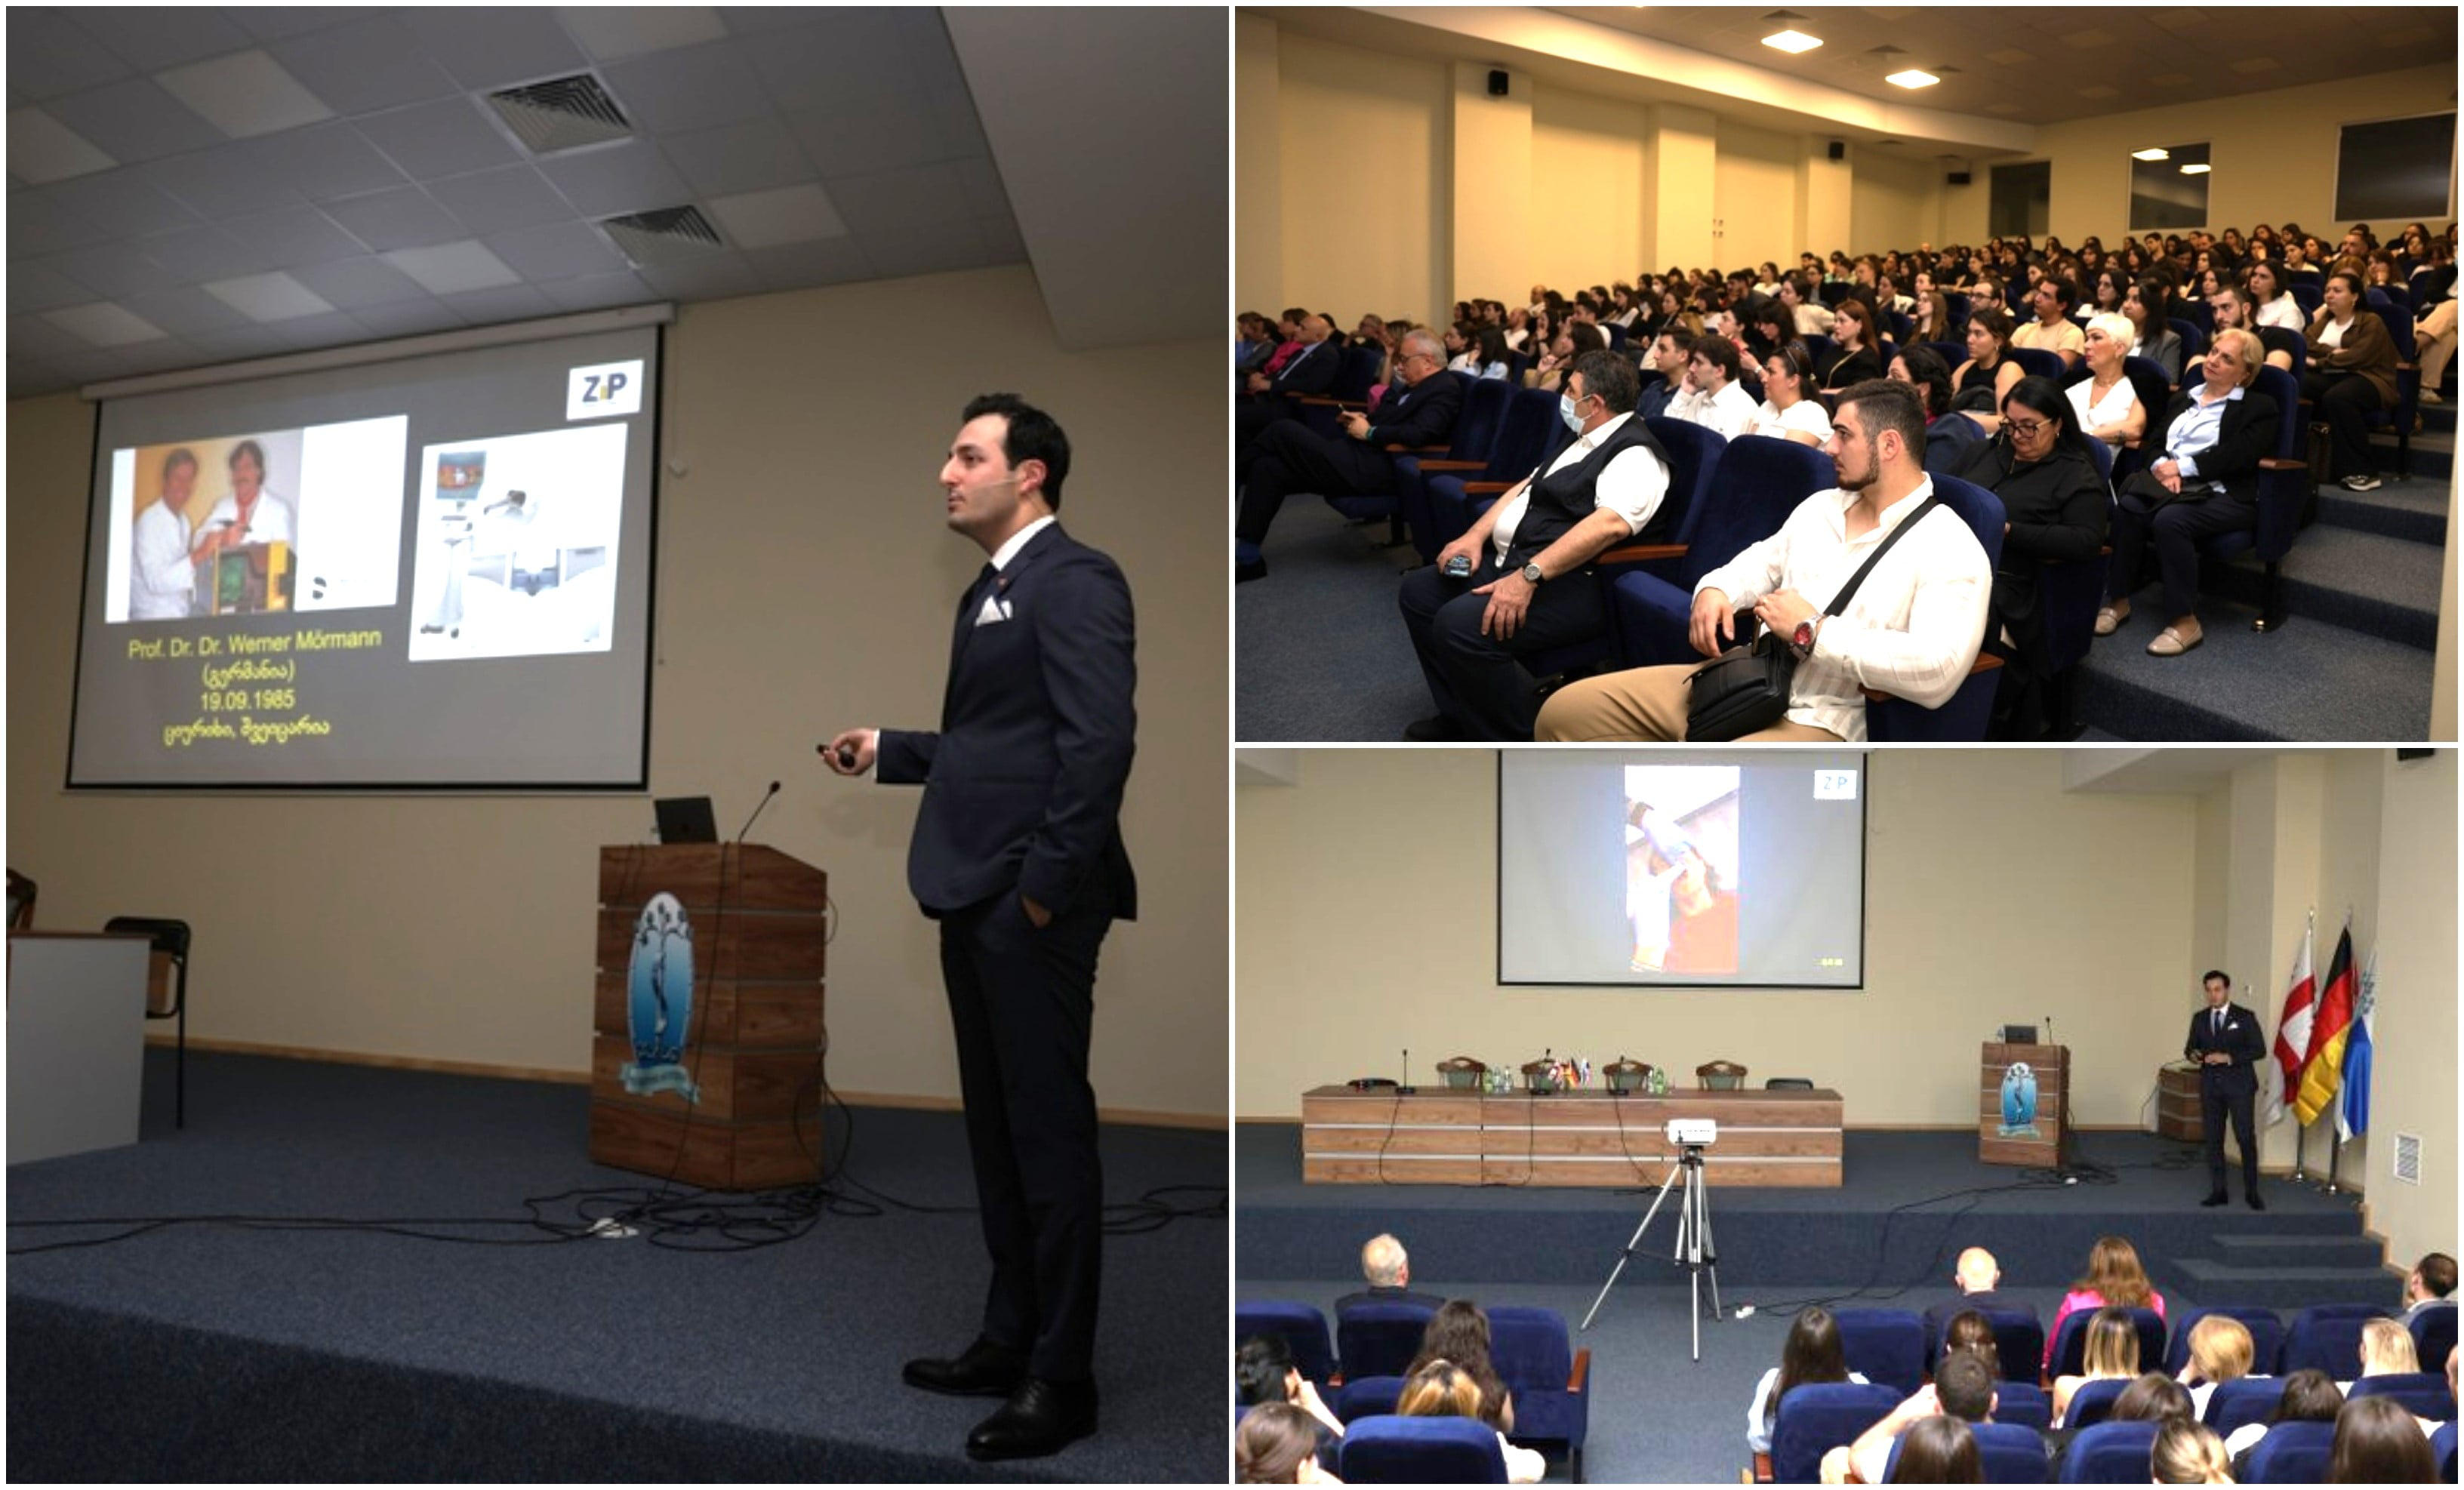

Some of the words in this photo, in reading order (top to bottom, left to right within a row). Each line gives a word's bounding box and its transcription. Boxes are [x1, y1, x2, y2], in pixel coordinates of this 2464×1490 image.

[129, 639, 165, 660] Prof.
[170, 637, 192, 657] Dr.
[199, 636, 223, 657] Dr.
[228, 634, 291, 655] Werner
[295, 629, 381, 651] Mörmann
[201, 688, 295, 712] 19.09.1985
